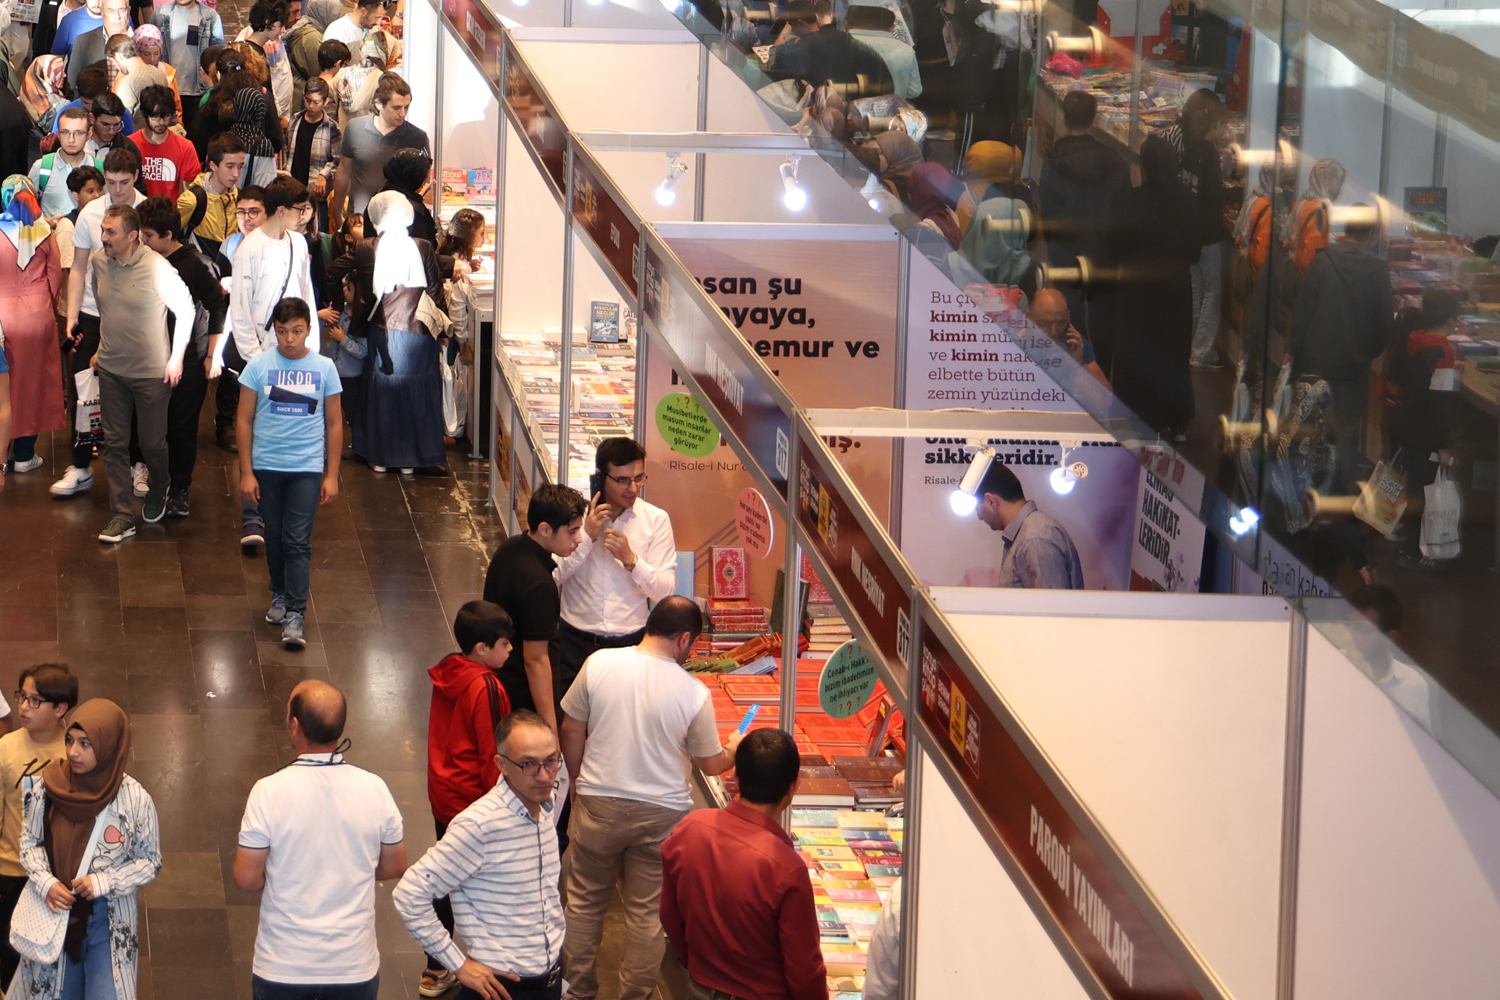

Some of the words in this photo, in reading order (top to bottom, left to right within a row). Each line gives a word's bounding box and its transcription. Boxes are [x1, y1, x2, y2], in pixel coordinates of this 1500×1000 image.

[144, 157, 163, 165] THE
[768, 278, 801, 300] şu
[930, 291, 952, 304] Bu
[930, 310, 978, 323] kimin
[929, 329, 978, 343] kimin
[750, 340, 834, 358] emur
[844, 341, 880, 358] ve
[929, 351, 947, 361] ve
[951, 349, 999, 362] kimin
[928, 368, 983, 381] elbette
[987, 368, 1036, 382] bütün
[927, 387, 976, 400] zemin
[980, 388, 1066, 403] yüzündeki
[666, 404, 708, 424] Musibetlerde
[662, 413, 686, 427] masum
[685, 420, 712, 435] insanlar
[667, 424, 687, 438] neden
[688, 431, 706, 443] zarar
[673, 437, 699, 450] görüyor
[669, 460, 713, 471] Risale-i
[924, 448, 1060, 466] sikkeridir.
[1142, 487, 1181, 540] HAKİKAT-
[861, 559, 885, 618] NEŞRİYAT
[824, 680, 841, 692] bizim
[841, 666, 875, 686] ibadetimize
[827, 665, 850, 679] Cenab-ı
[829, 695, 837, 703] ne
[838, 685, 859, 701] ihtiyacı
[859, 681, 869, 691] var
[1030, 803, 1071, 898] PARODİ
[1072, 861, 1134, 989] YAYINLARI
